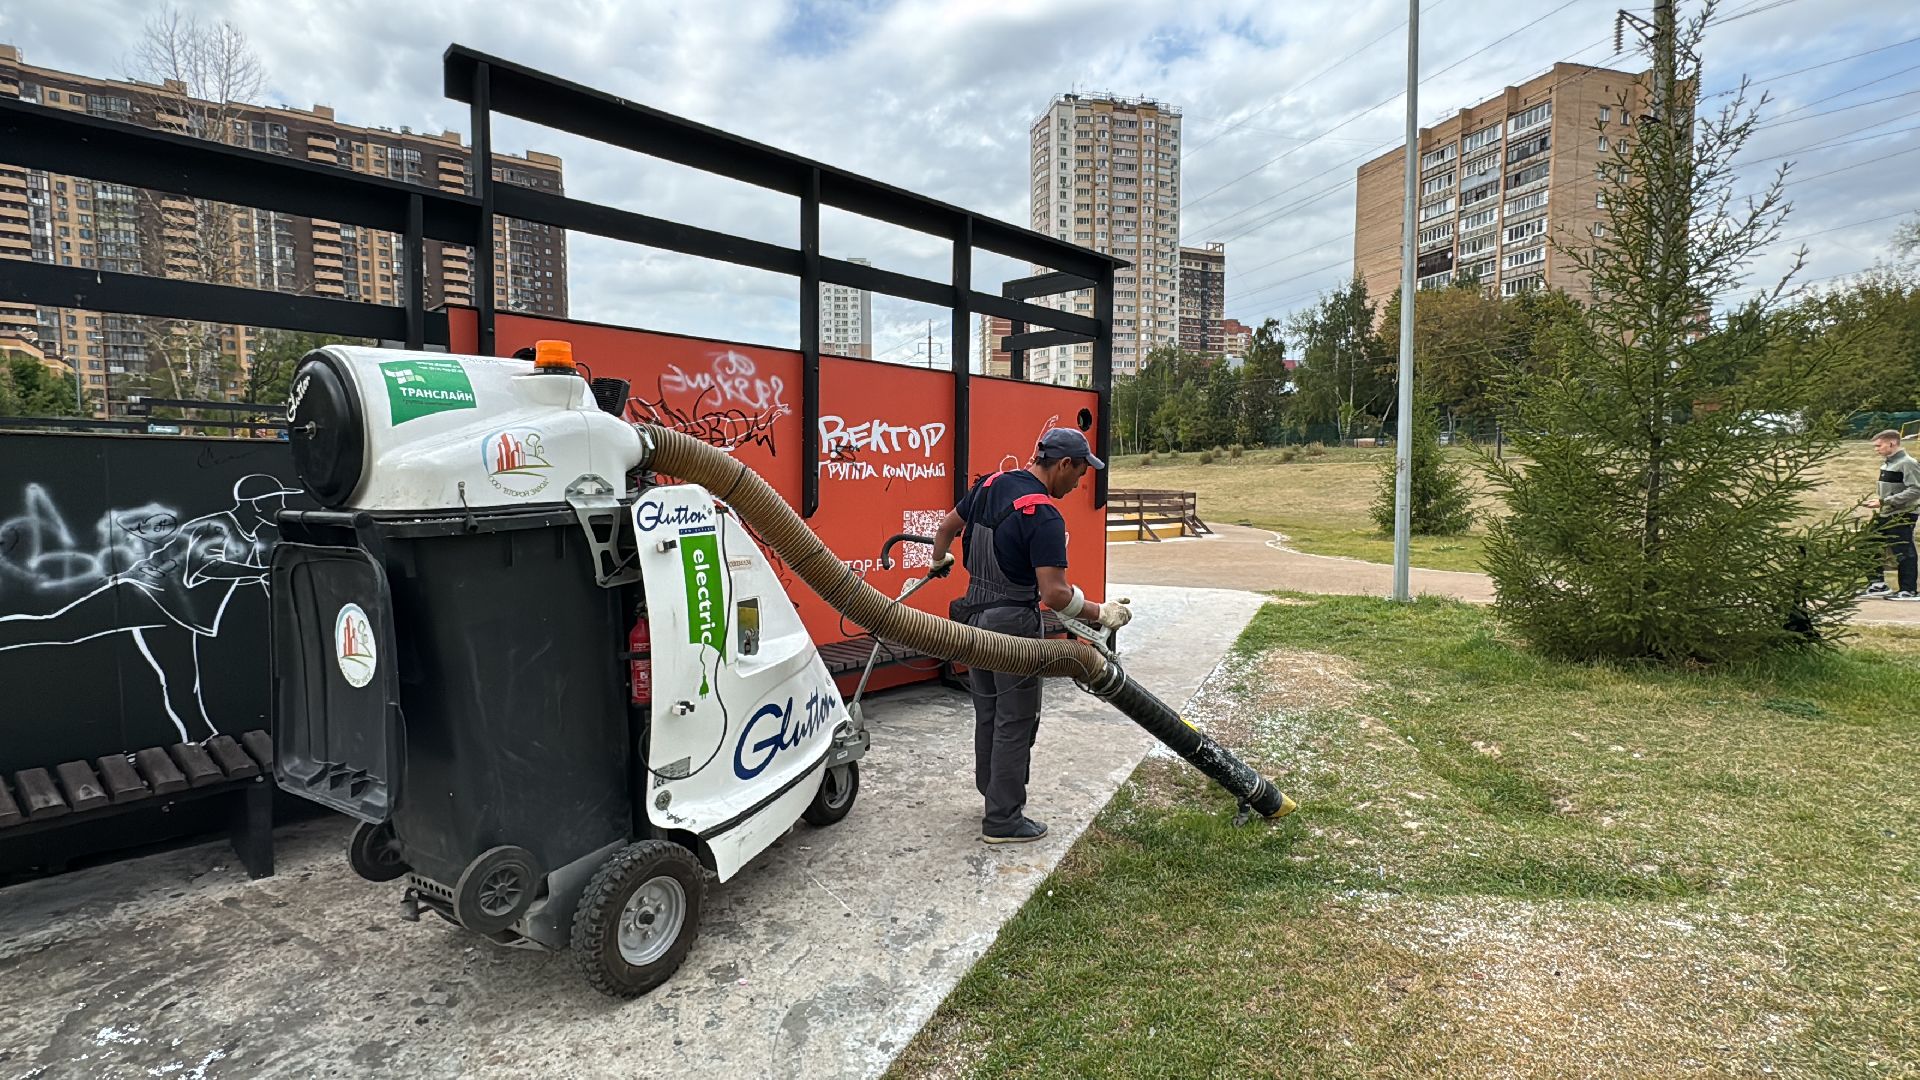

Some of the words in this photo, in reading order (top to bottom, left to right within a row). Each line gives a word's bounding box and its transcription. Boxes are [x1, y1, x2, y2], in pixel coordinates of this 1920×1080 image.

[399, 386, 473, 402] ТРАНСЛАЙН
[818, 415, 946, 459] ВЕКТОР
[636, 501, 707, 532] Glutton
[693, 549, 716, 645] electric
[733, 685, 836, 780] Glutton
